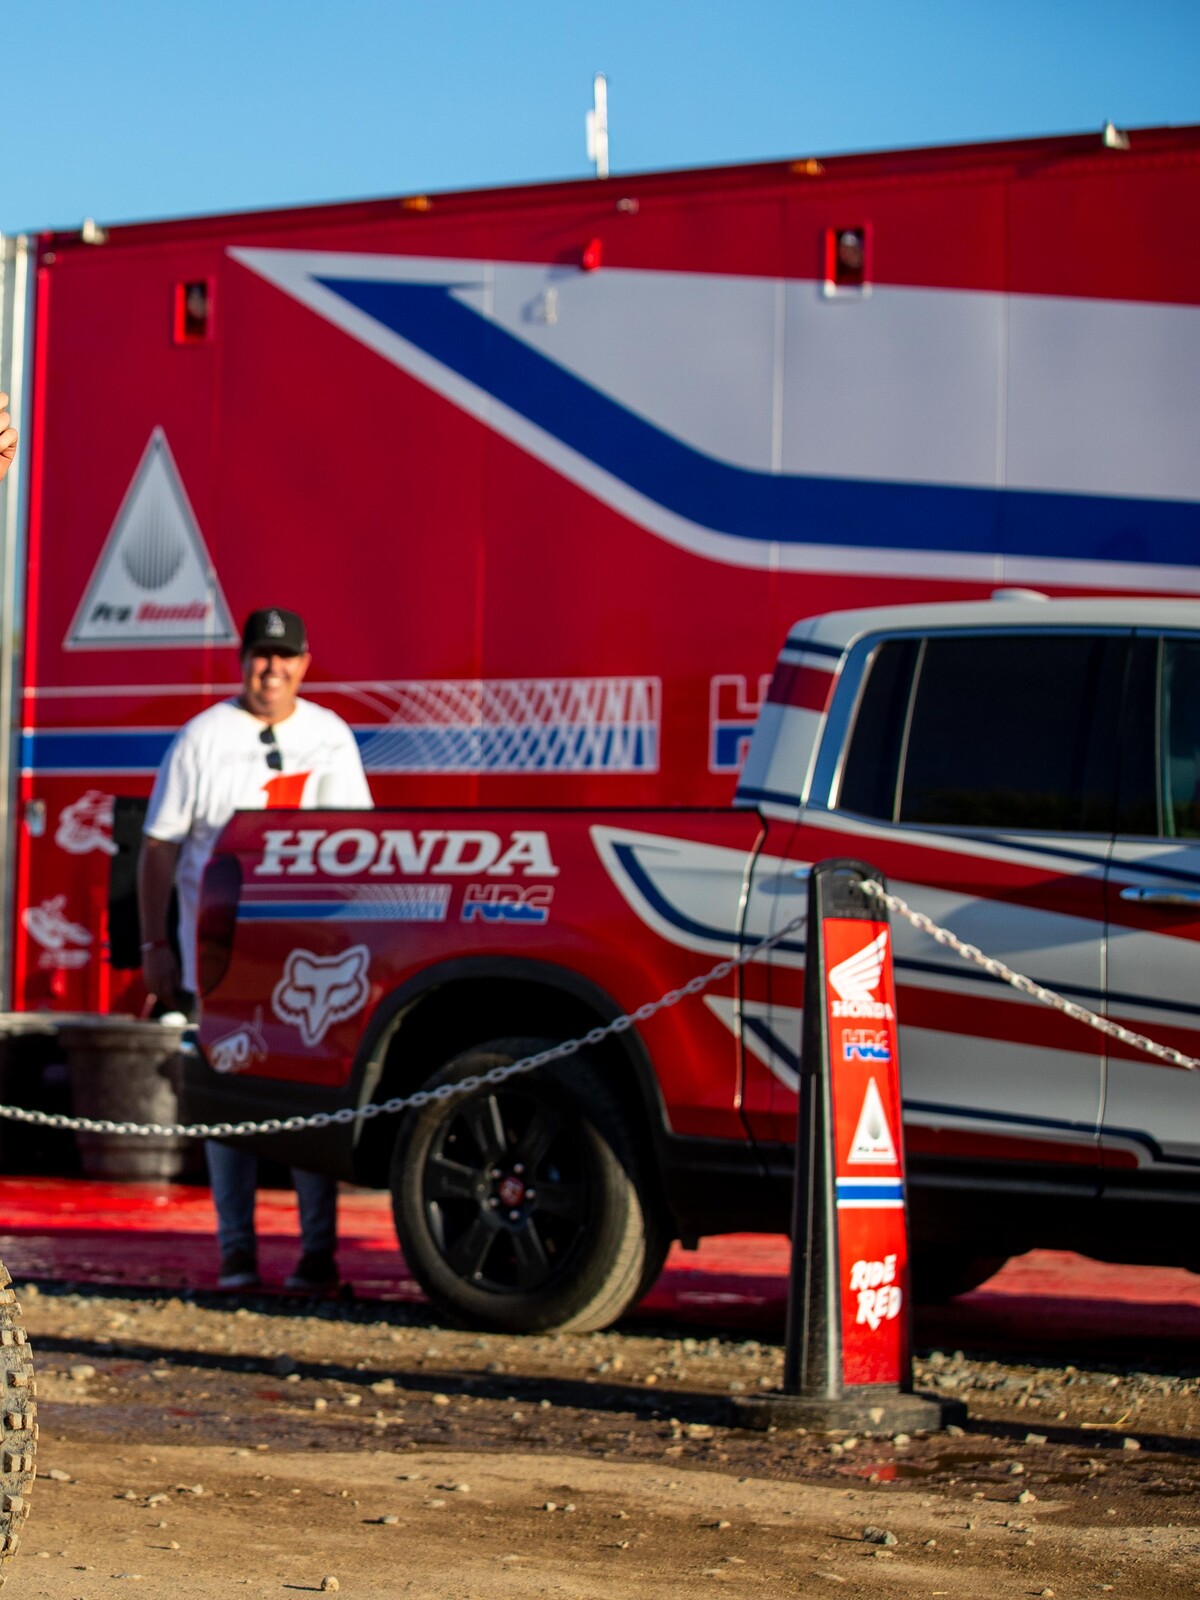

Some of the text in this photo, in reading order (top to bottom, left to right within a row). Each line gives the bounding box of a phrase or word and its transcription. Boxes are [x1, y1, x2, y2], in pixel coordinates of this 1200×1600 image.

[255, 828, 559, 876] HONDA
[460, 884, 554, 924] HRC
[831, 1000, 894, 1020] HONDA
[850, 1254, 897, 1291] RIDE
[856, 1286, 902, 1331] RED
